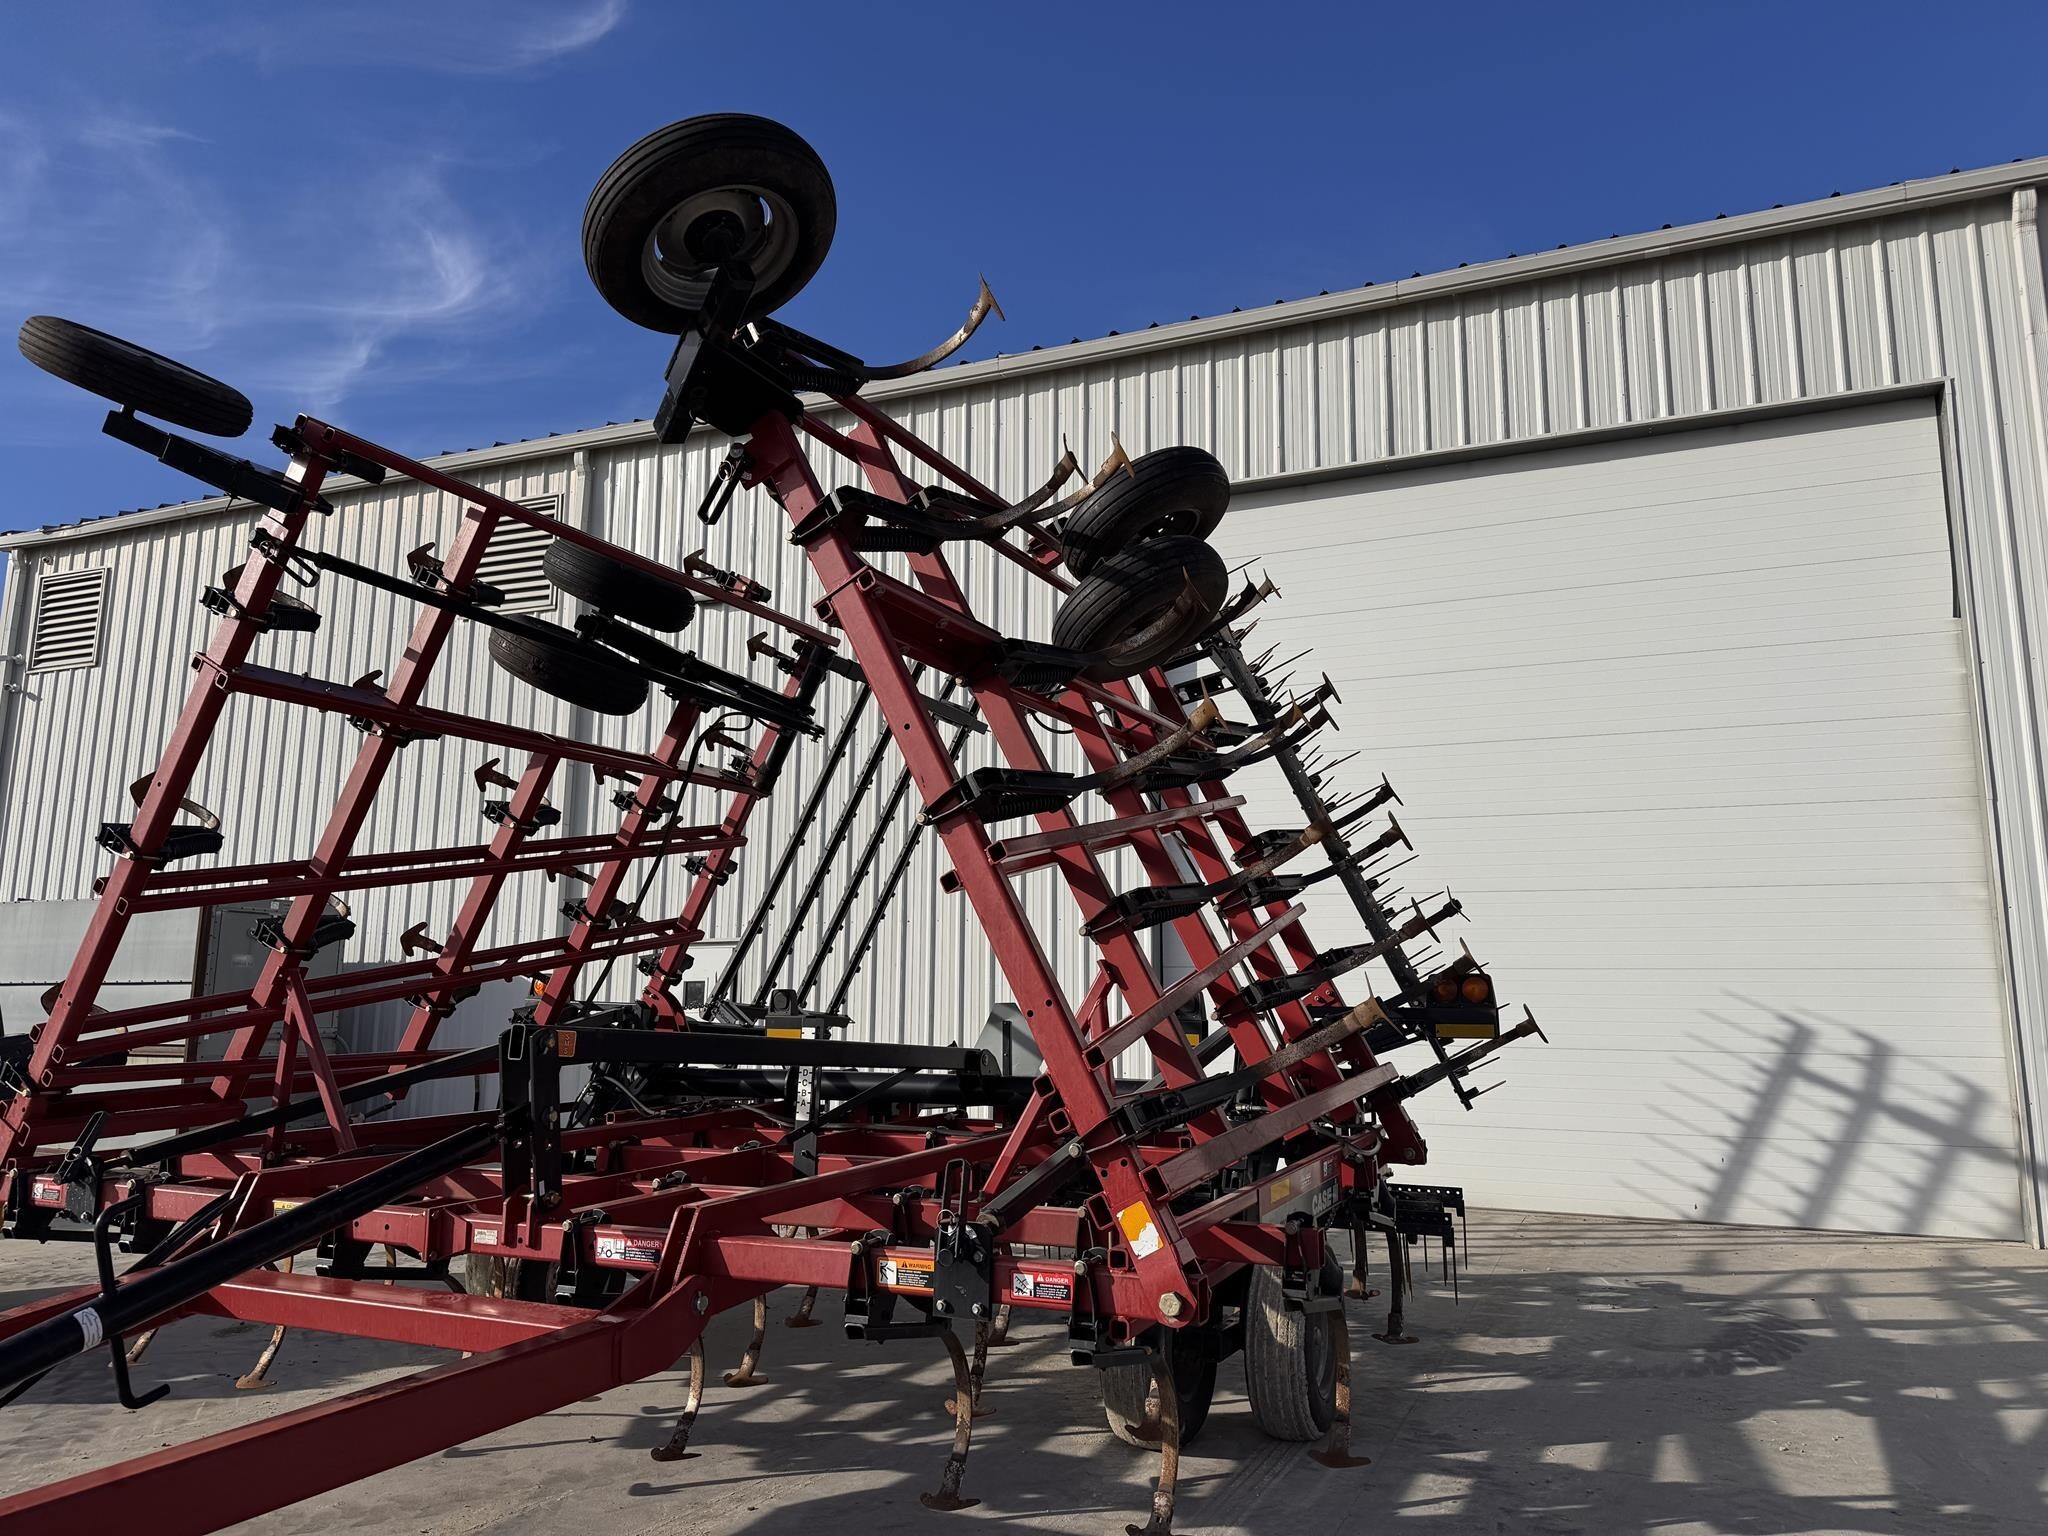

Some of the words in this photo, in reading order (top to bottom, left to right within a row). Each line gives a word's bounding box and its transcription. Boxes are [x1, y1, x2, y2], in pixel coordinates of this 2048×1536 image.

[802, 1068, 809, 1077] D
[801, 1078, 808, 1087] C
[801, 1089, 807, 1097] B
[800, 1099, 806, 1107] A
[1312, 1187, 1333, 1216] CASE
[633, 1239, 660, 1248] DANGER
[1045, 1276, 1069, 1284] DANGER
